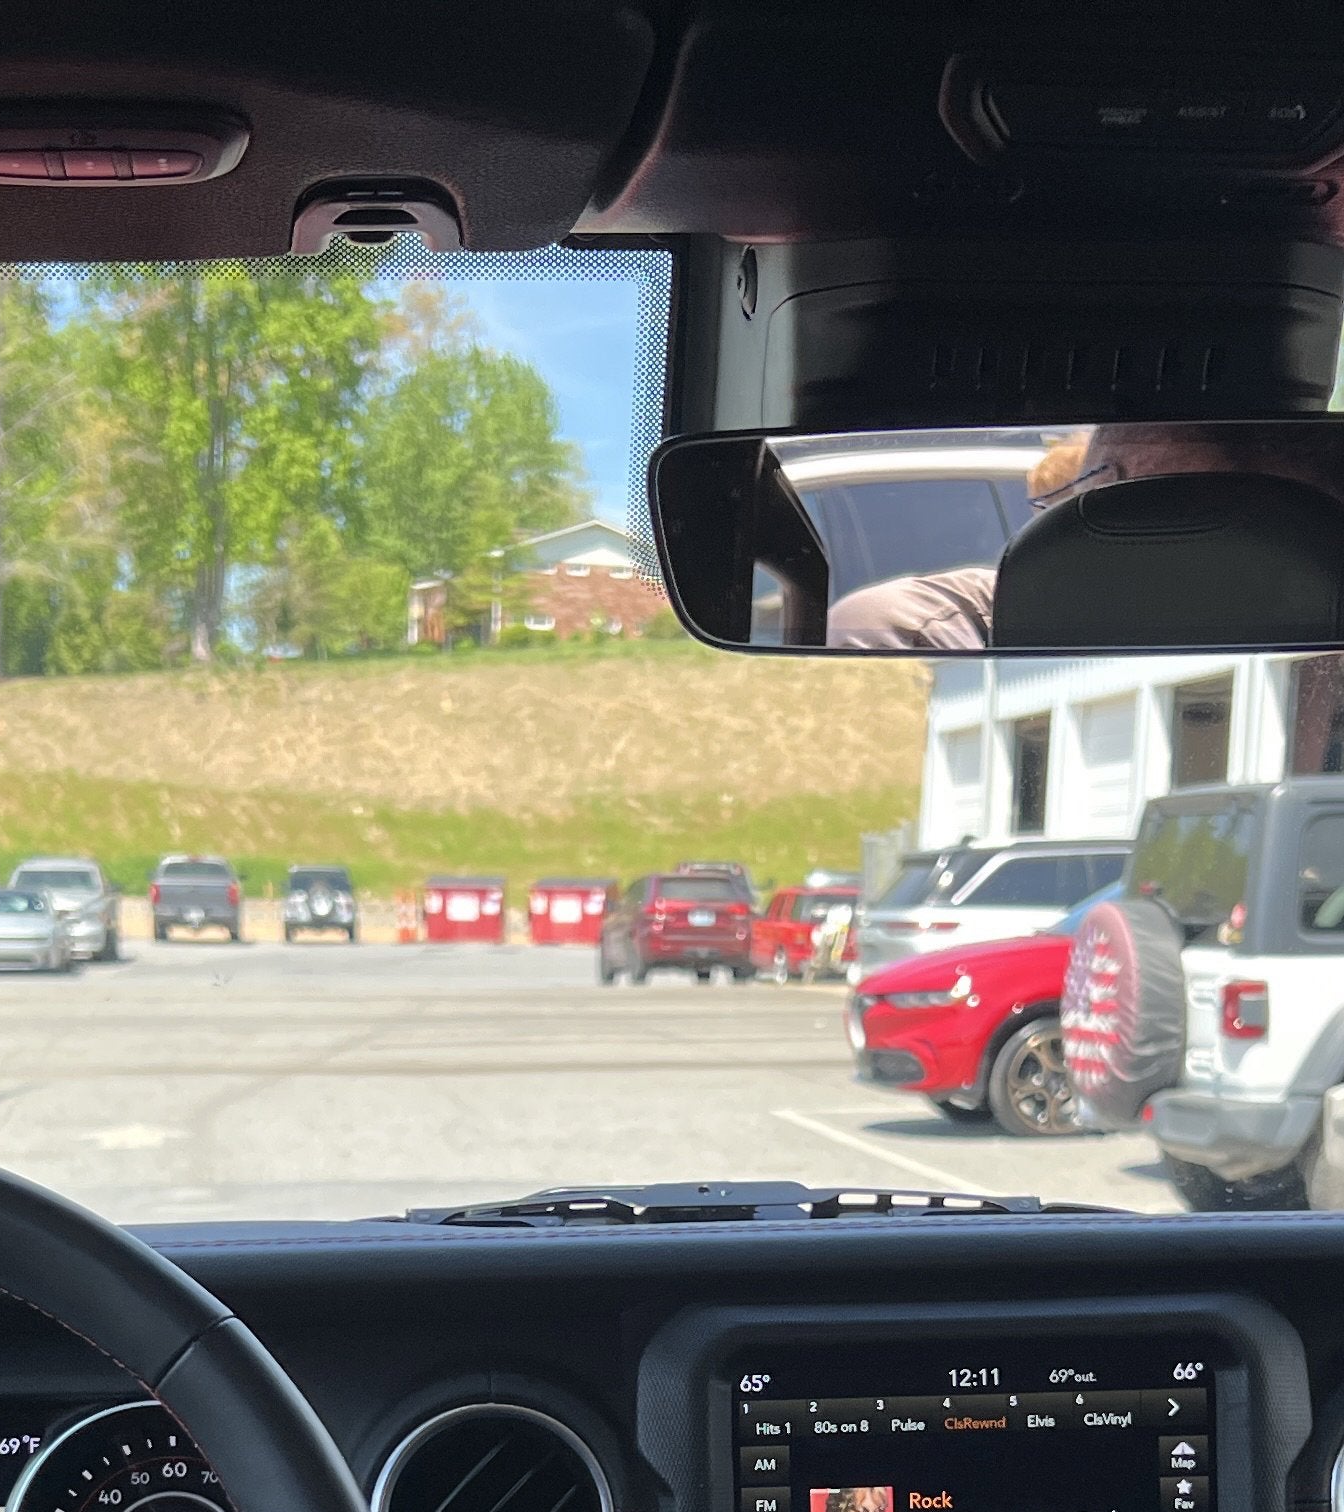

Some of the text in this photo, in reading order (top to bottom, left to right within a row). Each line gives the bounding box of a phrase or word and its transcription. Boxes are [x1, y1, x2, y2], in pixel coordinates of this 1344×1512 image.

[948, 1368, 1000, 1388] 12:11
[1173, 1363, 1204, 1380] 66°
[740, 1374, 771, 1392] 65°
[876, 1400, 884, 1411] 3
[943, 1397, 951, 1409] 4
[1009, 1396, 1017, 1407] 5
[1075, 1393, 1084, 1405] 6
[743, 1403, 748, 1415] 1
[809, 1401, 817, 1412] 2
[814, 1419, 868, 1434] 80s on 8
[891, 1418, 925, 1432] Pulse
[944, 1417, 1006, 1430] ClsRewnd
[1027, 1414, 1055, 1428] Elvis
[1084, 1412, 1132, 1428] ClsVinyl
[756, 1422, 791, 1435] Hits 1
[162, 1462, 187, 1478] 60
[754, 1459, 776, 1471] AM
[1171, 1457, 1196, 1471] Map
[131, 1472, 150, 1485] 50
[201, 1471, 218, 1484] 70
[98, 1489, 122, 1504] 40
[909, 1493, 953, 1509] Rock
[756, 1500, 777, 1512] FM
[1174, 1498, 1194, 1510] Fav
